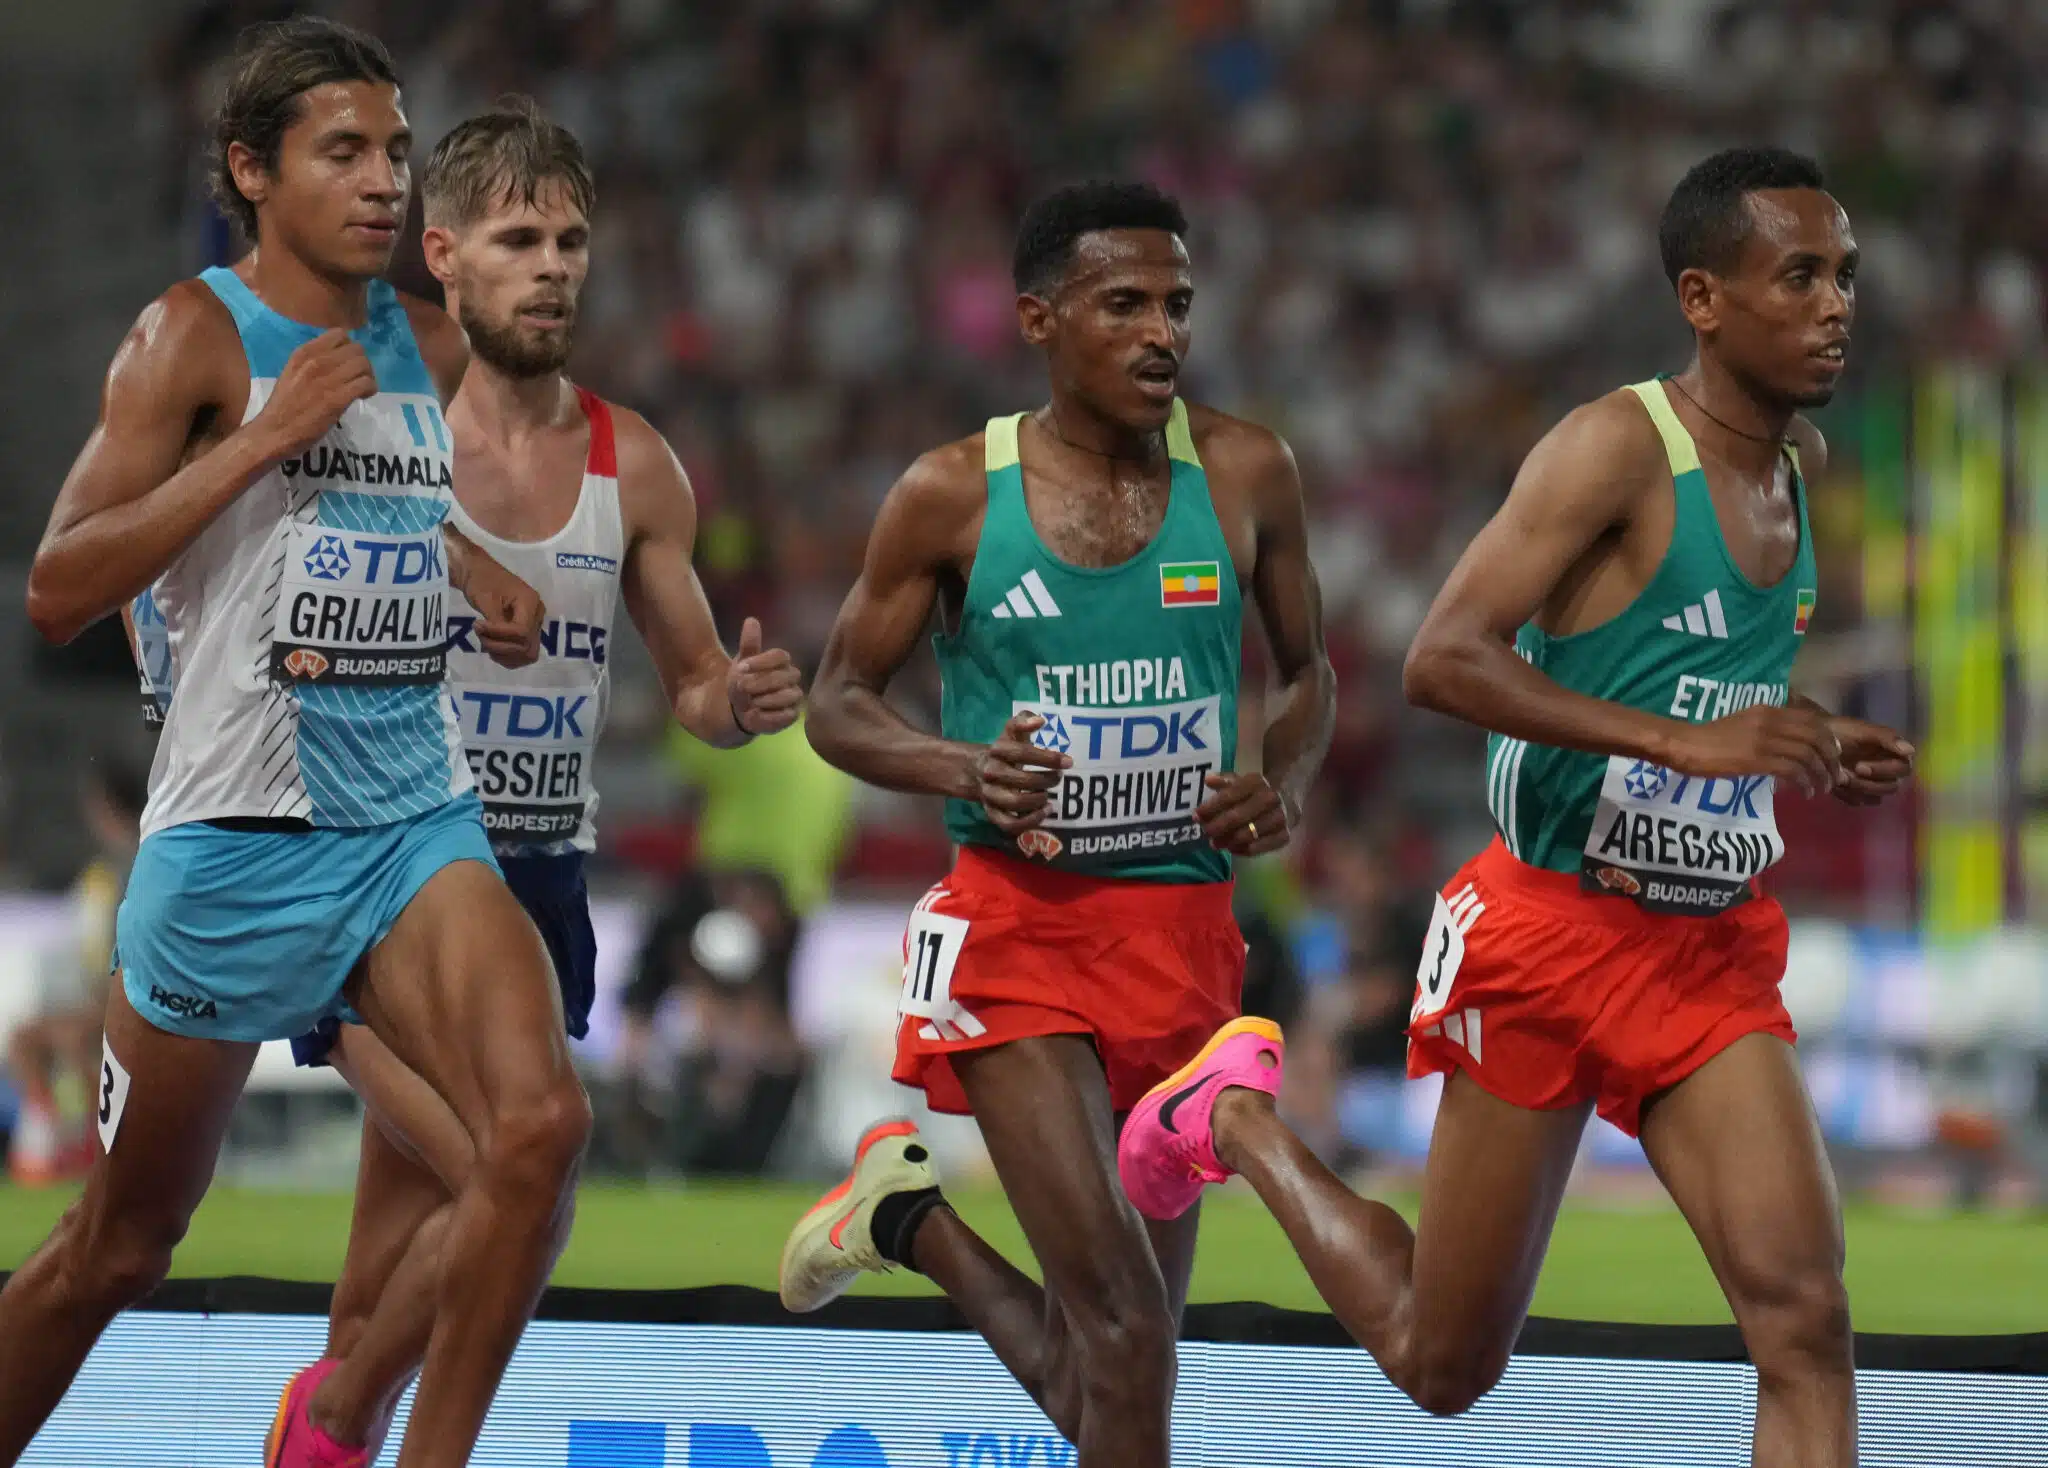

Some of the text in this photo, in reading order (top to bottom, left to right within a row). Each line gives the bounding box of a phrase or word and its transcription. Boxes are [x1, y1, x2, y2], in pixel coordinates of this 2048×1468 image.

[353, 535, 443, 585] TDK
[290, 591, 443, 644] GRIJALVA
[446, 615, 607, 665] RNCE
[1035, 656, 1187, 706] ETHIOPIA
[463, 690, 588, 740] TDK
[1071, 706, 1208, 760] TDK
[465, 748, 582, 799] ESSIER
[1600, 810, 1774, 875] AREGAWI
[911, 929, 944, 1003] 11
[1429, 922, 1450, 995] 3
[150, 983, 218, 1020] HOKA
